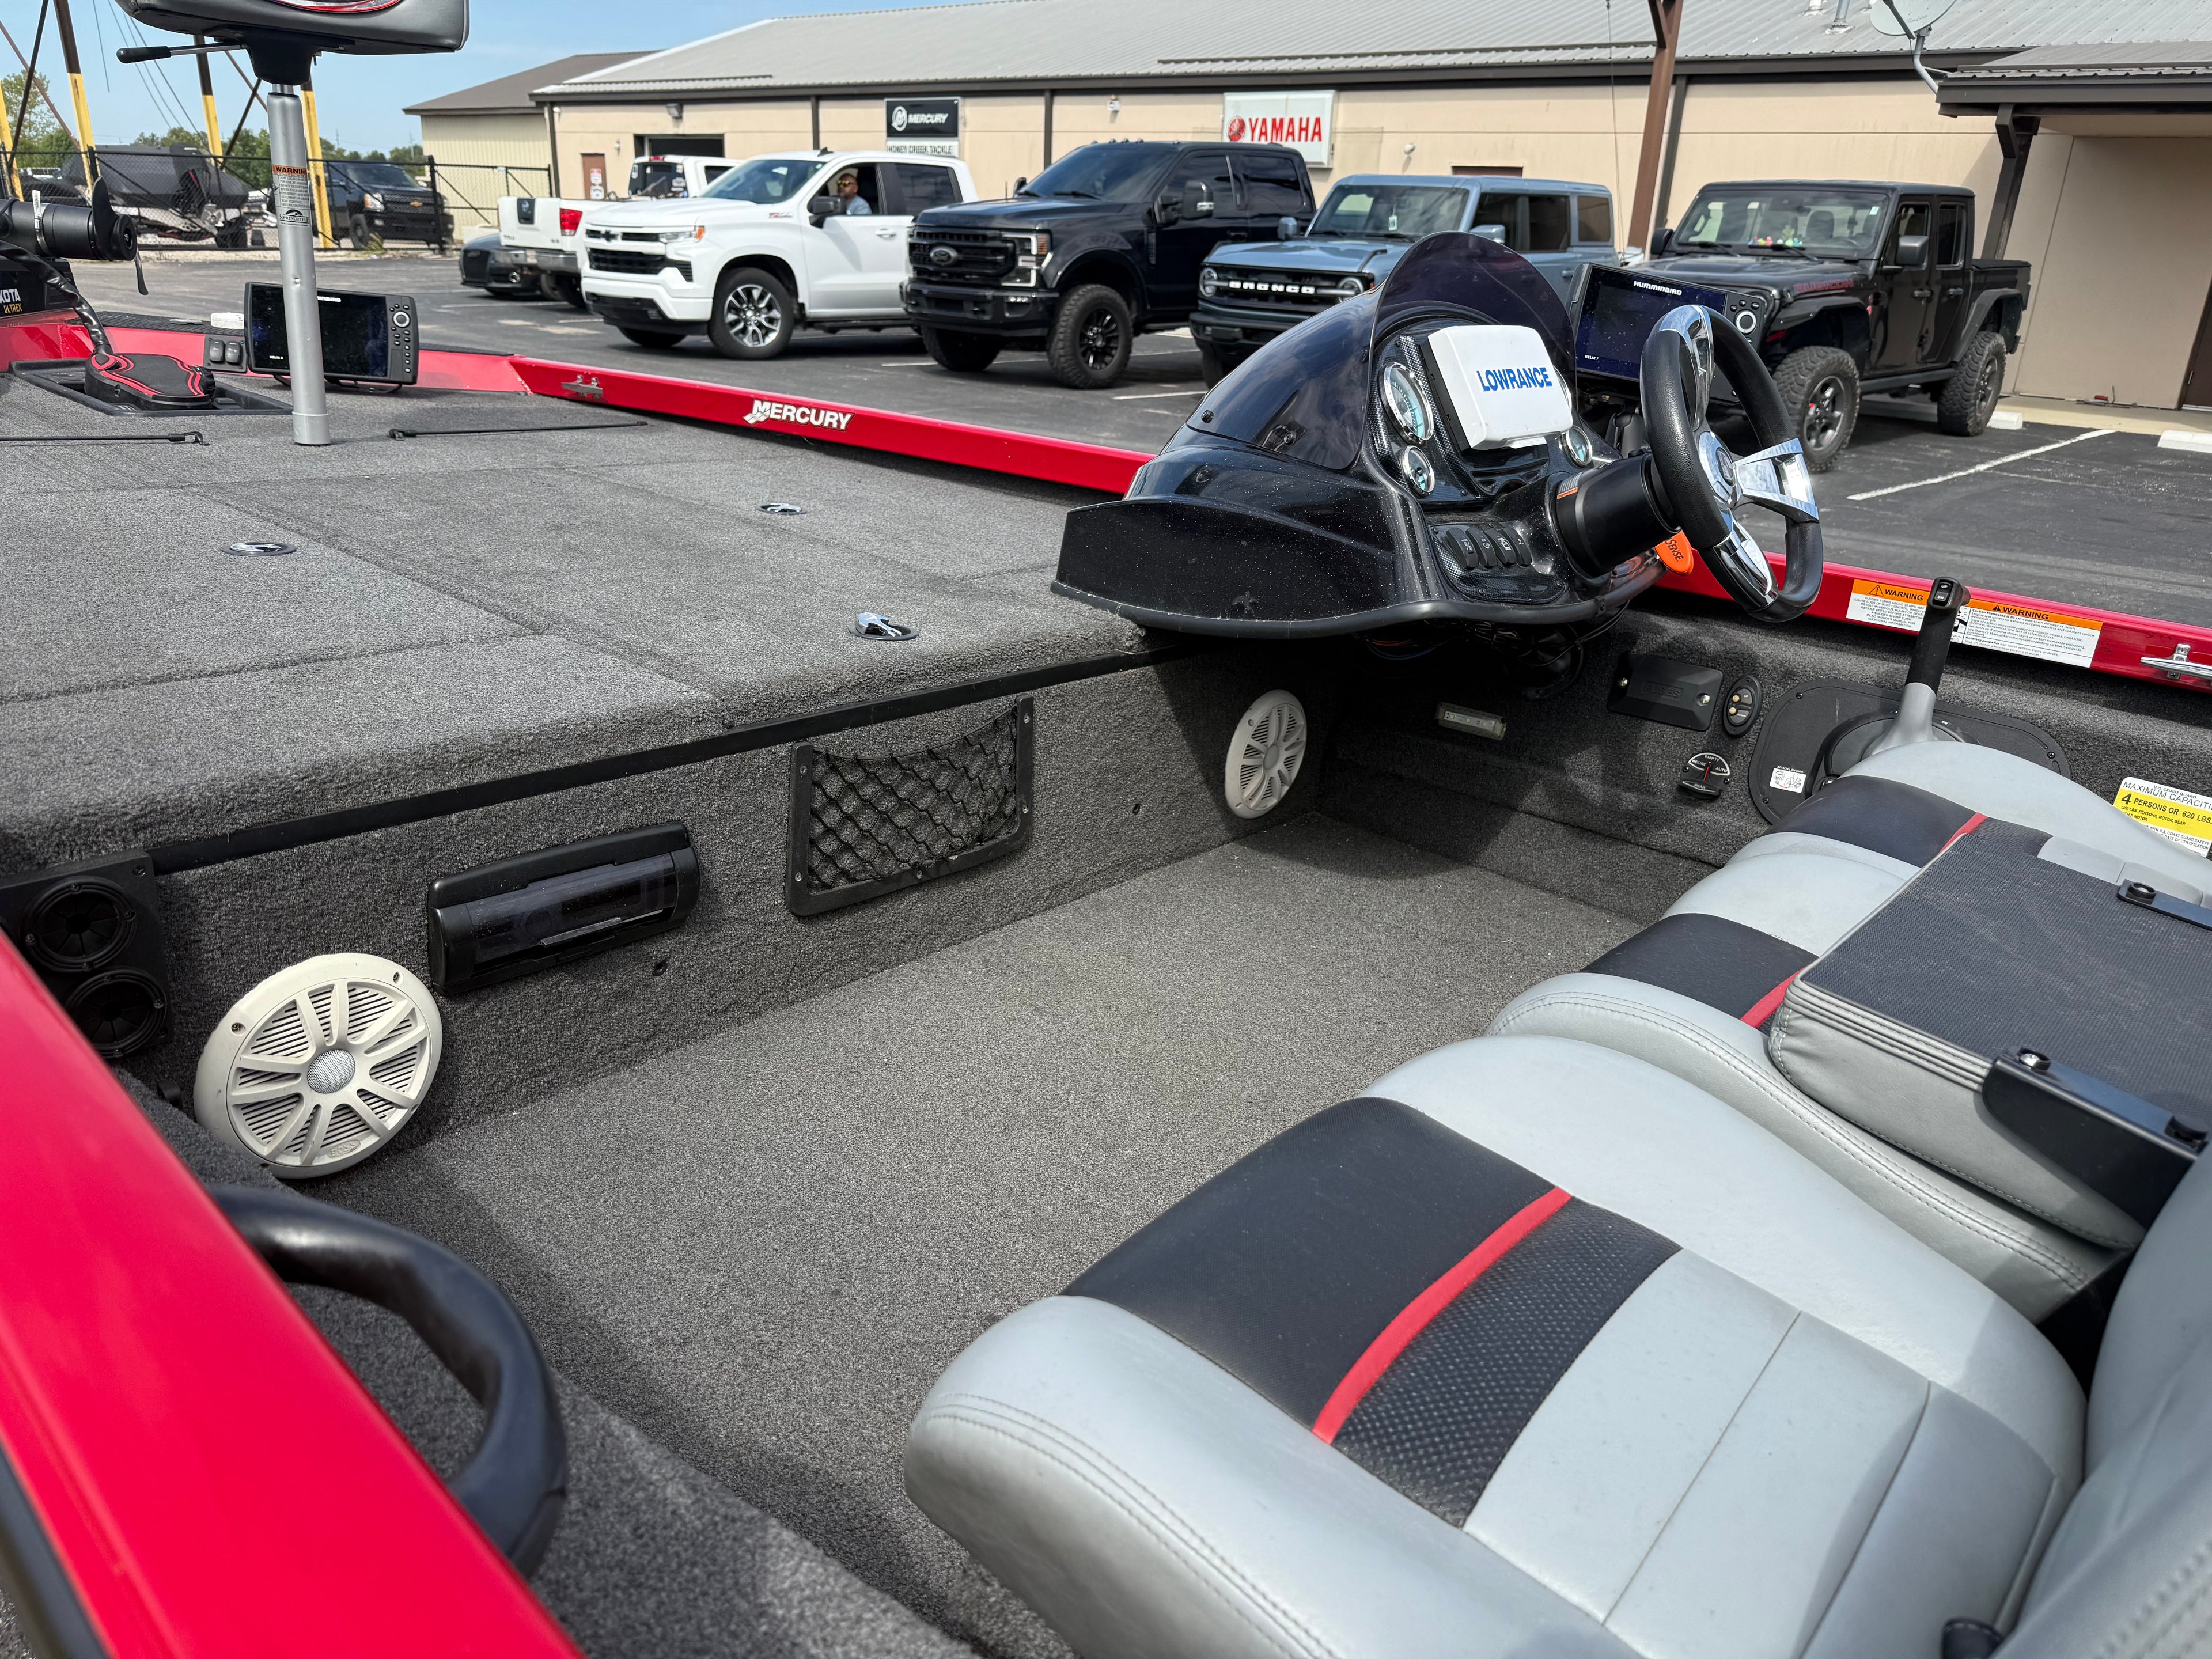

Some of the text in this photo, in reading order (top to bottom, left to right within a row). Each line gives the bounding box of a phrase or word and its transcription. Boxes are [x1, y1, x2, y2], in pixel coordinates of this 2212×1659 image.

[907, 113, 949, 124] MERCURY
[1248, 116, 1322, 142] YAMAHA
[1229, 281, 1315, 294] BRONCO
[1633, 281, 1683, 296] HUMMINBIRD
[3, 303, 22, 314] ULTREX
[1476, 367, 1552, 392] LOWRANCE
[743, 399, 853, 430] MERCURY
[1884, 589, 1923, 601] WARNING
[2003, 607, 2049, 620] WARNING
[2123, 781, 2212, 810] MAXIMUM CAPACITI
[2122, 793, 2212, 824] 4 PERSONS OR 620 LBS.
[2138, 810, 2158, 818] PERSONS,
